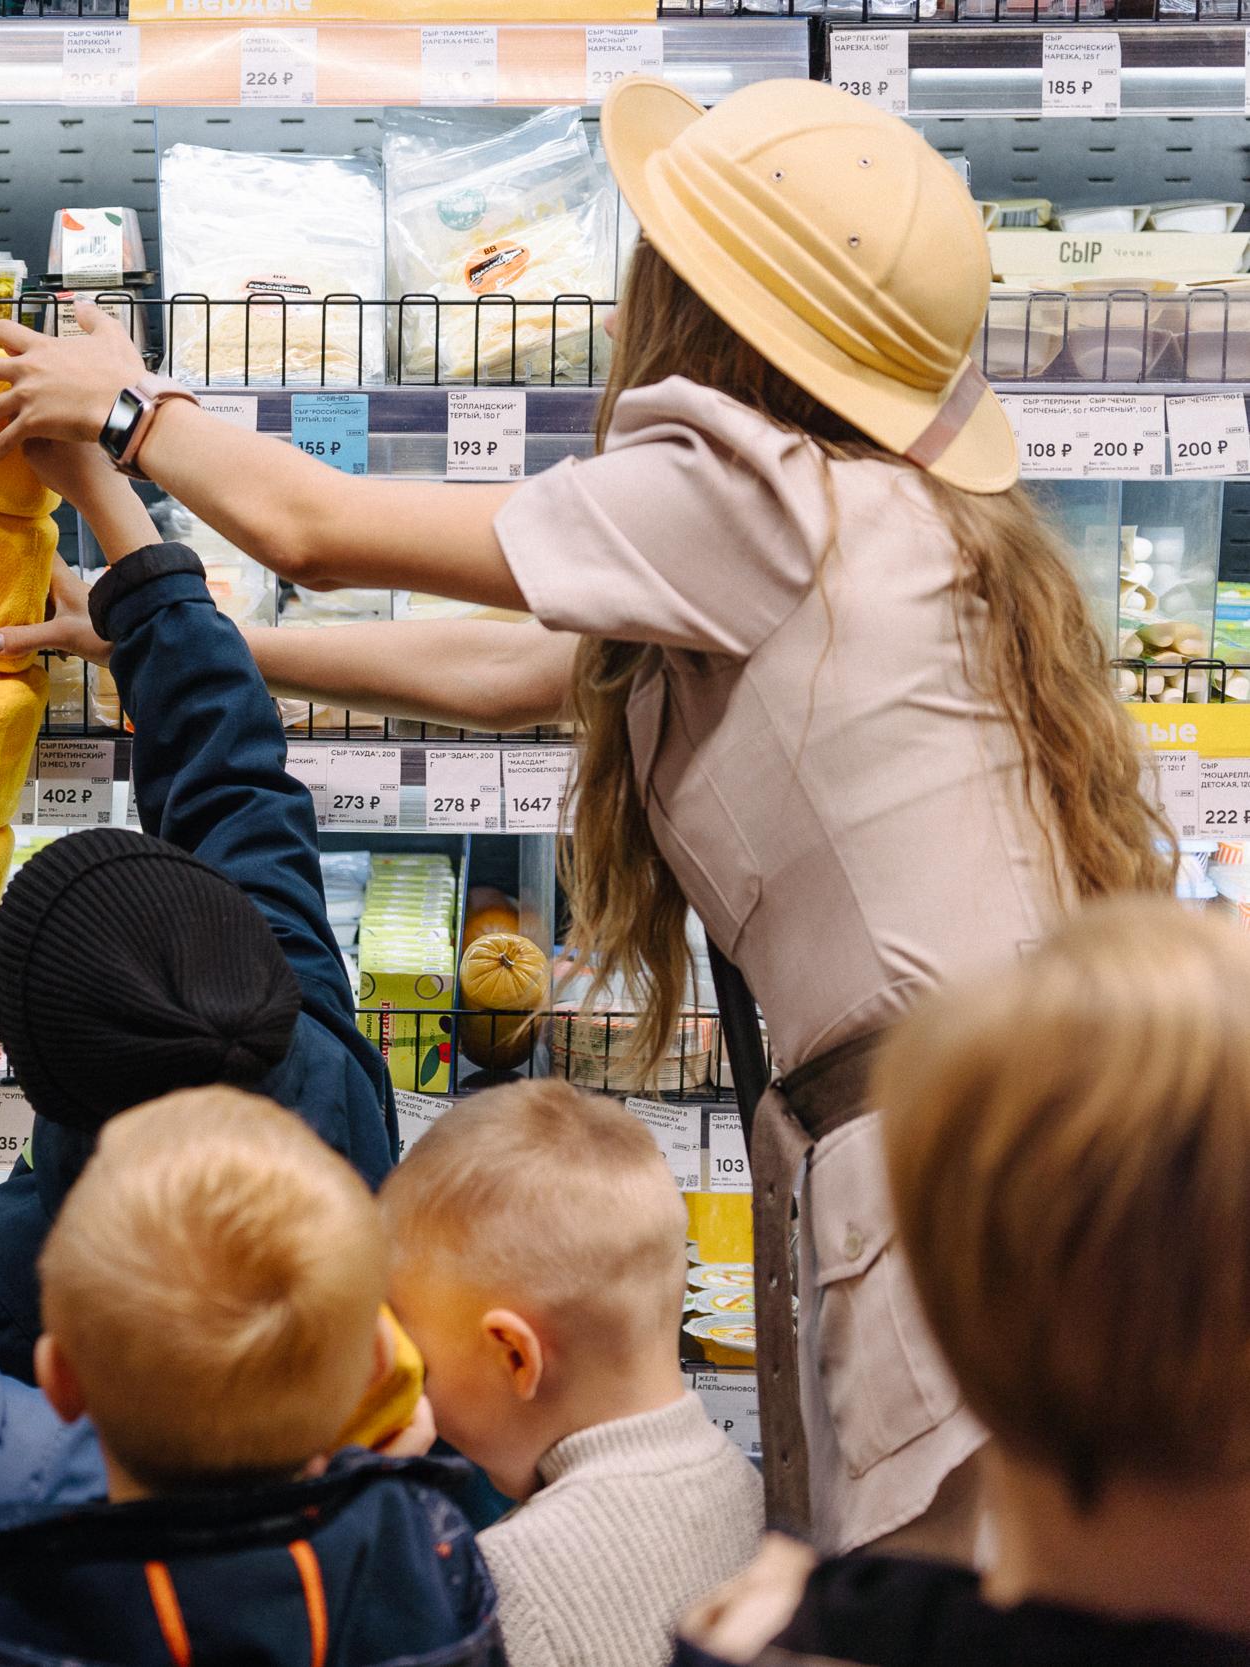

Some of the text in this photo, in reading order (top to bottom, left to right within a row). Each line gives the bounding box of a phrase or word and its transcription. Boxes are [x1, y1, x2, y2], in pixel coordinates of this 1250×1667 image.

[588, 29, 638, 37] СЫР "ЧЕДДЕР
[1045, 43, 1117, 51] "КЛАССИЧЕСКИЙ"
[1044, 53, 1082, 61] НАРЕЗКА,
[1083, 53, 1095, 61] 125
[246, 72, 277, 85] 226
[838, 82, 872, 96] 238
[1048, 80, 1076, 94] 185
[1059, 241, 1102, 263] СЫР
[450, 402, 517, 410] "ГОЛЛАНДСКИЙ"
[1089, 397, 1136, 405] СЫР "ЧЕЧИЛ
[450, 411, 481, 420] ТЕРТЫЙ,
[483, 411, 495, 420] 150
[1089, 405, 1137, 414] КОПЧЕНЫЙ",
[1139, 405, 1151, 414] 100
[298, 442, 325, 456] 155
[453, 442, 481, 456] 193
[1026, 443, 1055, 457] 108
[1094, 443, 1127, 456] 200
[1178, 442, 1212, 457] 200
[40, 742, 99, 751] СЫР ПАРМЕЗАН
[40, 752, 107, 760] "АРГЕНТИНСКИЙ"
[331, 750, 396, 758] СЫР "ГАУДА", 200
[430, 752, 494, 760] СЫР "ЭДАМ", 200
[43, 789, 76, 804] 402
[333, 796, 364, 810] 273
[433, 797, 465, 812] 278
[513, 797, 552, 812] 1647
[715, 1159, 744, 1173] 103
[697, 1383, 757, 1393] АПЕЛЬСИНОВОЕ
